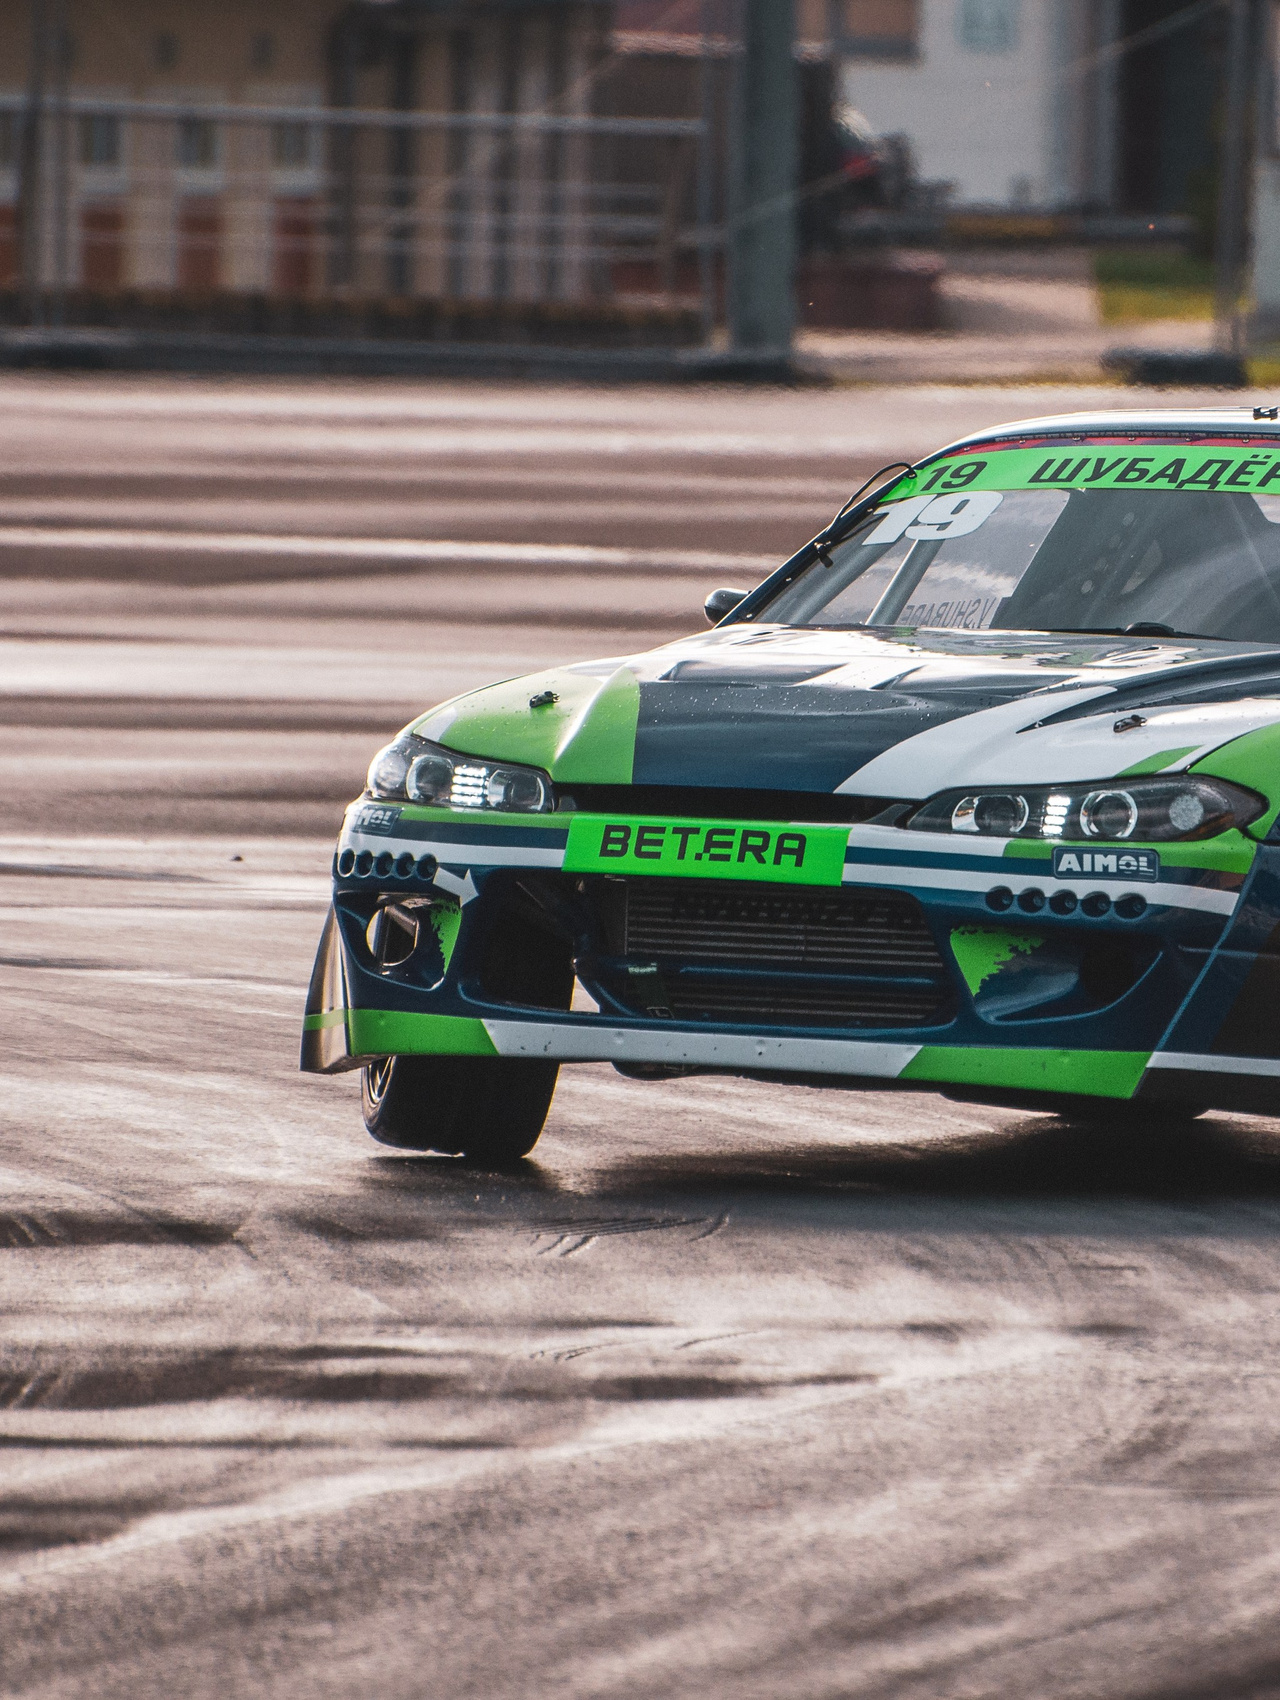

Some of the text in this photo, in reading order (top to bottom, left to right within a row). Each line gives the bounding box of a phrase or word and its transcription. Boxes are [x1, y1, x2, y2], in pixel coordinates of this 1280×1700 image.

[921, 461, 988, 491] 19
[862, 491, 1004, 546] 19
[353, 808, 393, 829] MOL
[1057, 853, 1154, 876] AIMOL
